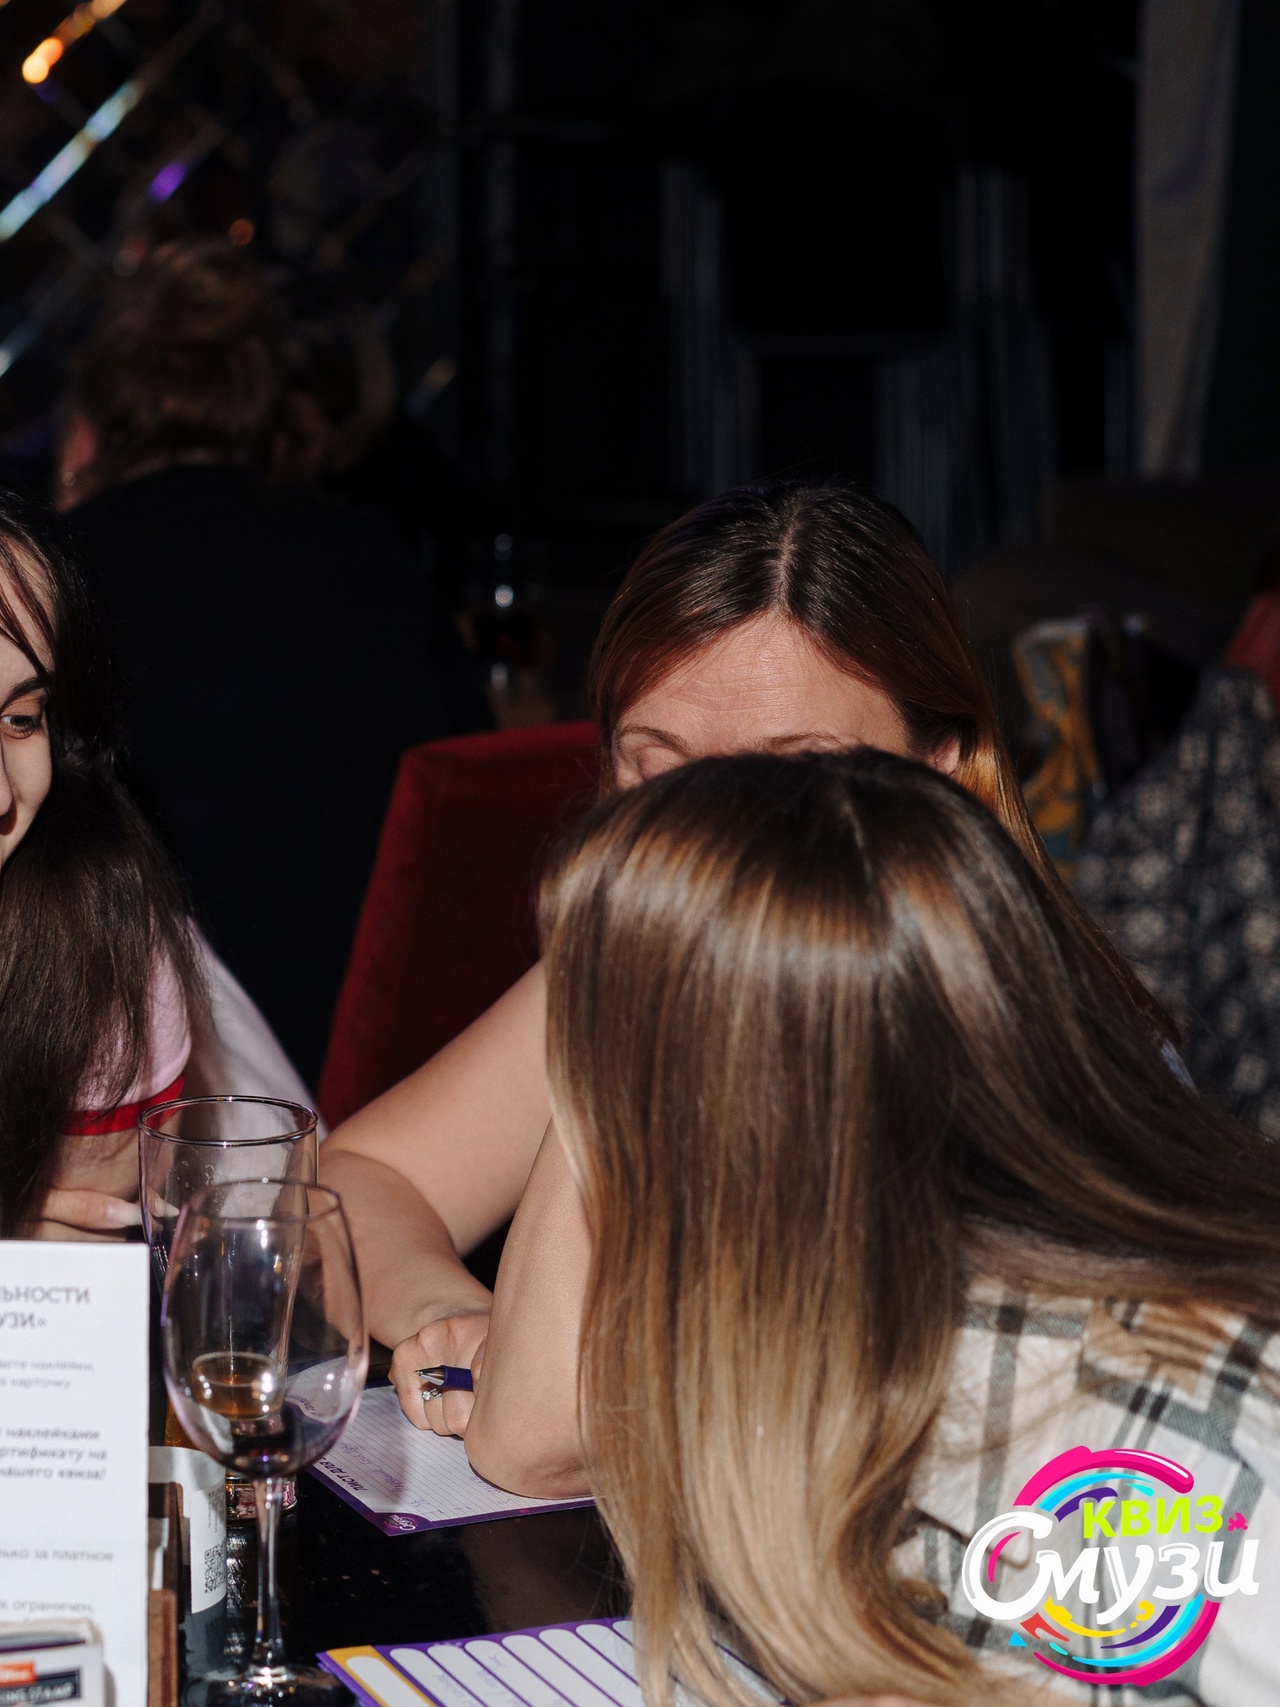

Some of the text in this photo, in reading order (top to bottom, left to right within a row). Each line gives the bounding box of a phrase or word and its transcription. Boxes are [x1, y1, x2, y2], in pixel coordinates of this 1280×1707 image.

[5, 1427, 100, 1439] наклейками
[88, 1449, 108, 1461] на
[57, 1466, 107, 1480] квиза!
[336, 1472, 368, 1492] ЛИСТ
[33, 1550, 49, 1560] за
[52, 1551, 115, 1562] платное
